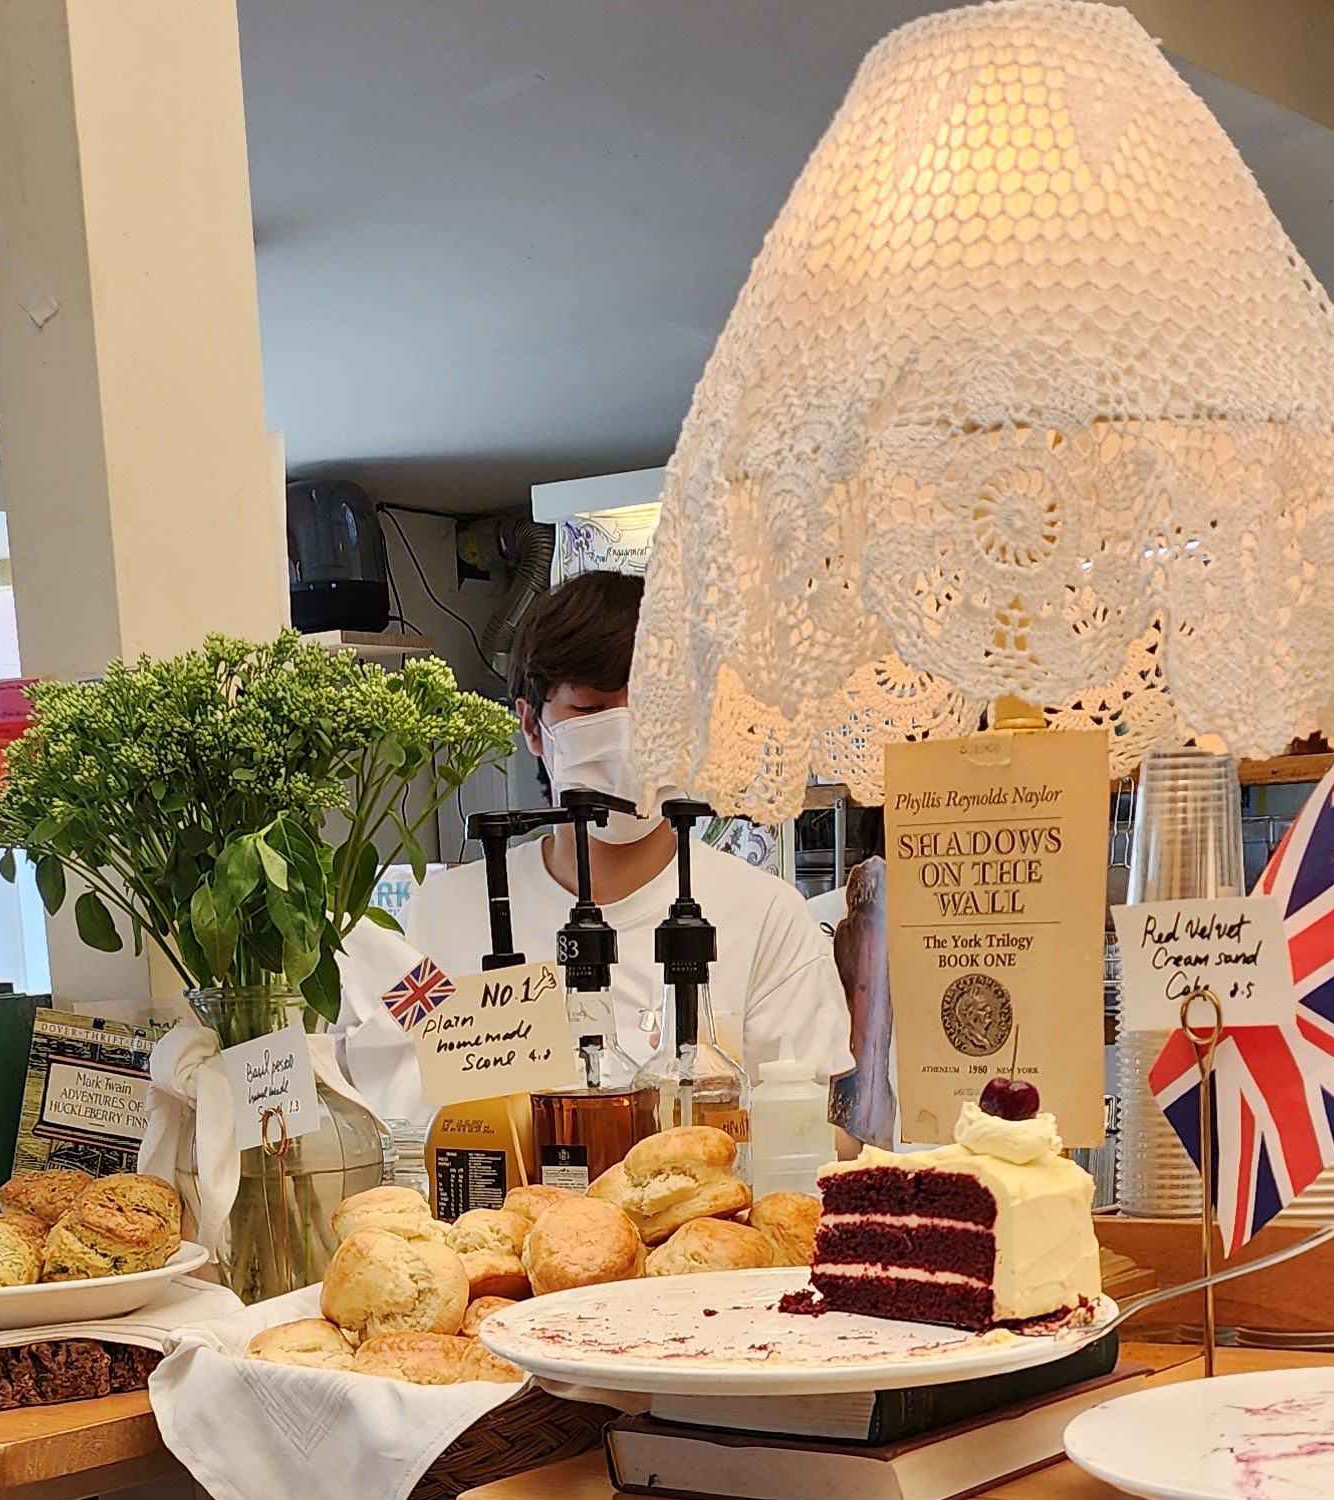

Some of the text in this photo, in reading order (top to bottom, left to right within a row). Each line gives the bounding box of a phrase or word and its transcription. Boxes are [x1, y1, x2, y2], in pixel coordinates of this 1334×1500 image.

[895, 785, 1062, 815] Phyllis Reynolds Naylor
[898, 827, 1062, 860] SHADOWS
[920, 859, 1043, 887] ON THE
[934, 890, 1025, 917] WALL
[923, 933, 1033, 950] The York Trilogy
[1141, 914, 1179, 948] Red
[938, 953, 1016, 967] BOOK ONE
[76, 1071, 132, 1095] Mark Twain
[49, 1100, 123, 1124] HUCKLEBERRY
[60, 1088, 145, 1112] ADVENTURES OF
